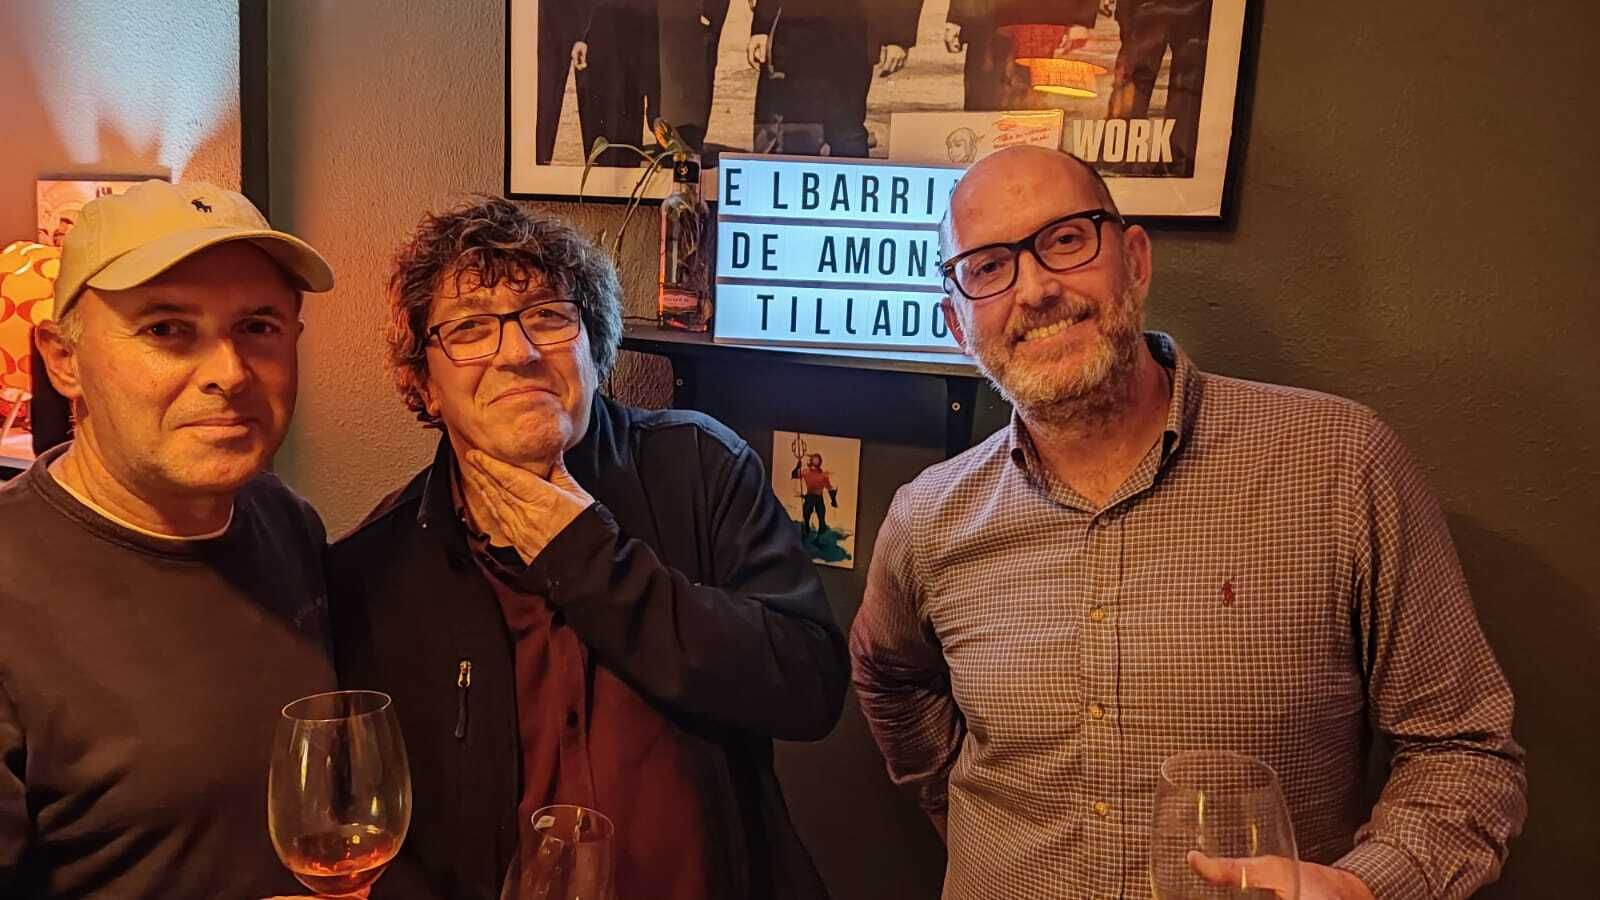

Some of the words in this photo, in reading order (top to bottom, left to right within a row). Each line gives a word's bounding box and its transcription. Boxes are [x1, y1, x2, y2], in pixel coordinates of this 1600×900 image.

[1072, 118, 1176, 163] WORK
[773, 171, 957, 215] LBARRI
[731, 231, 778, 271] DE
